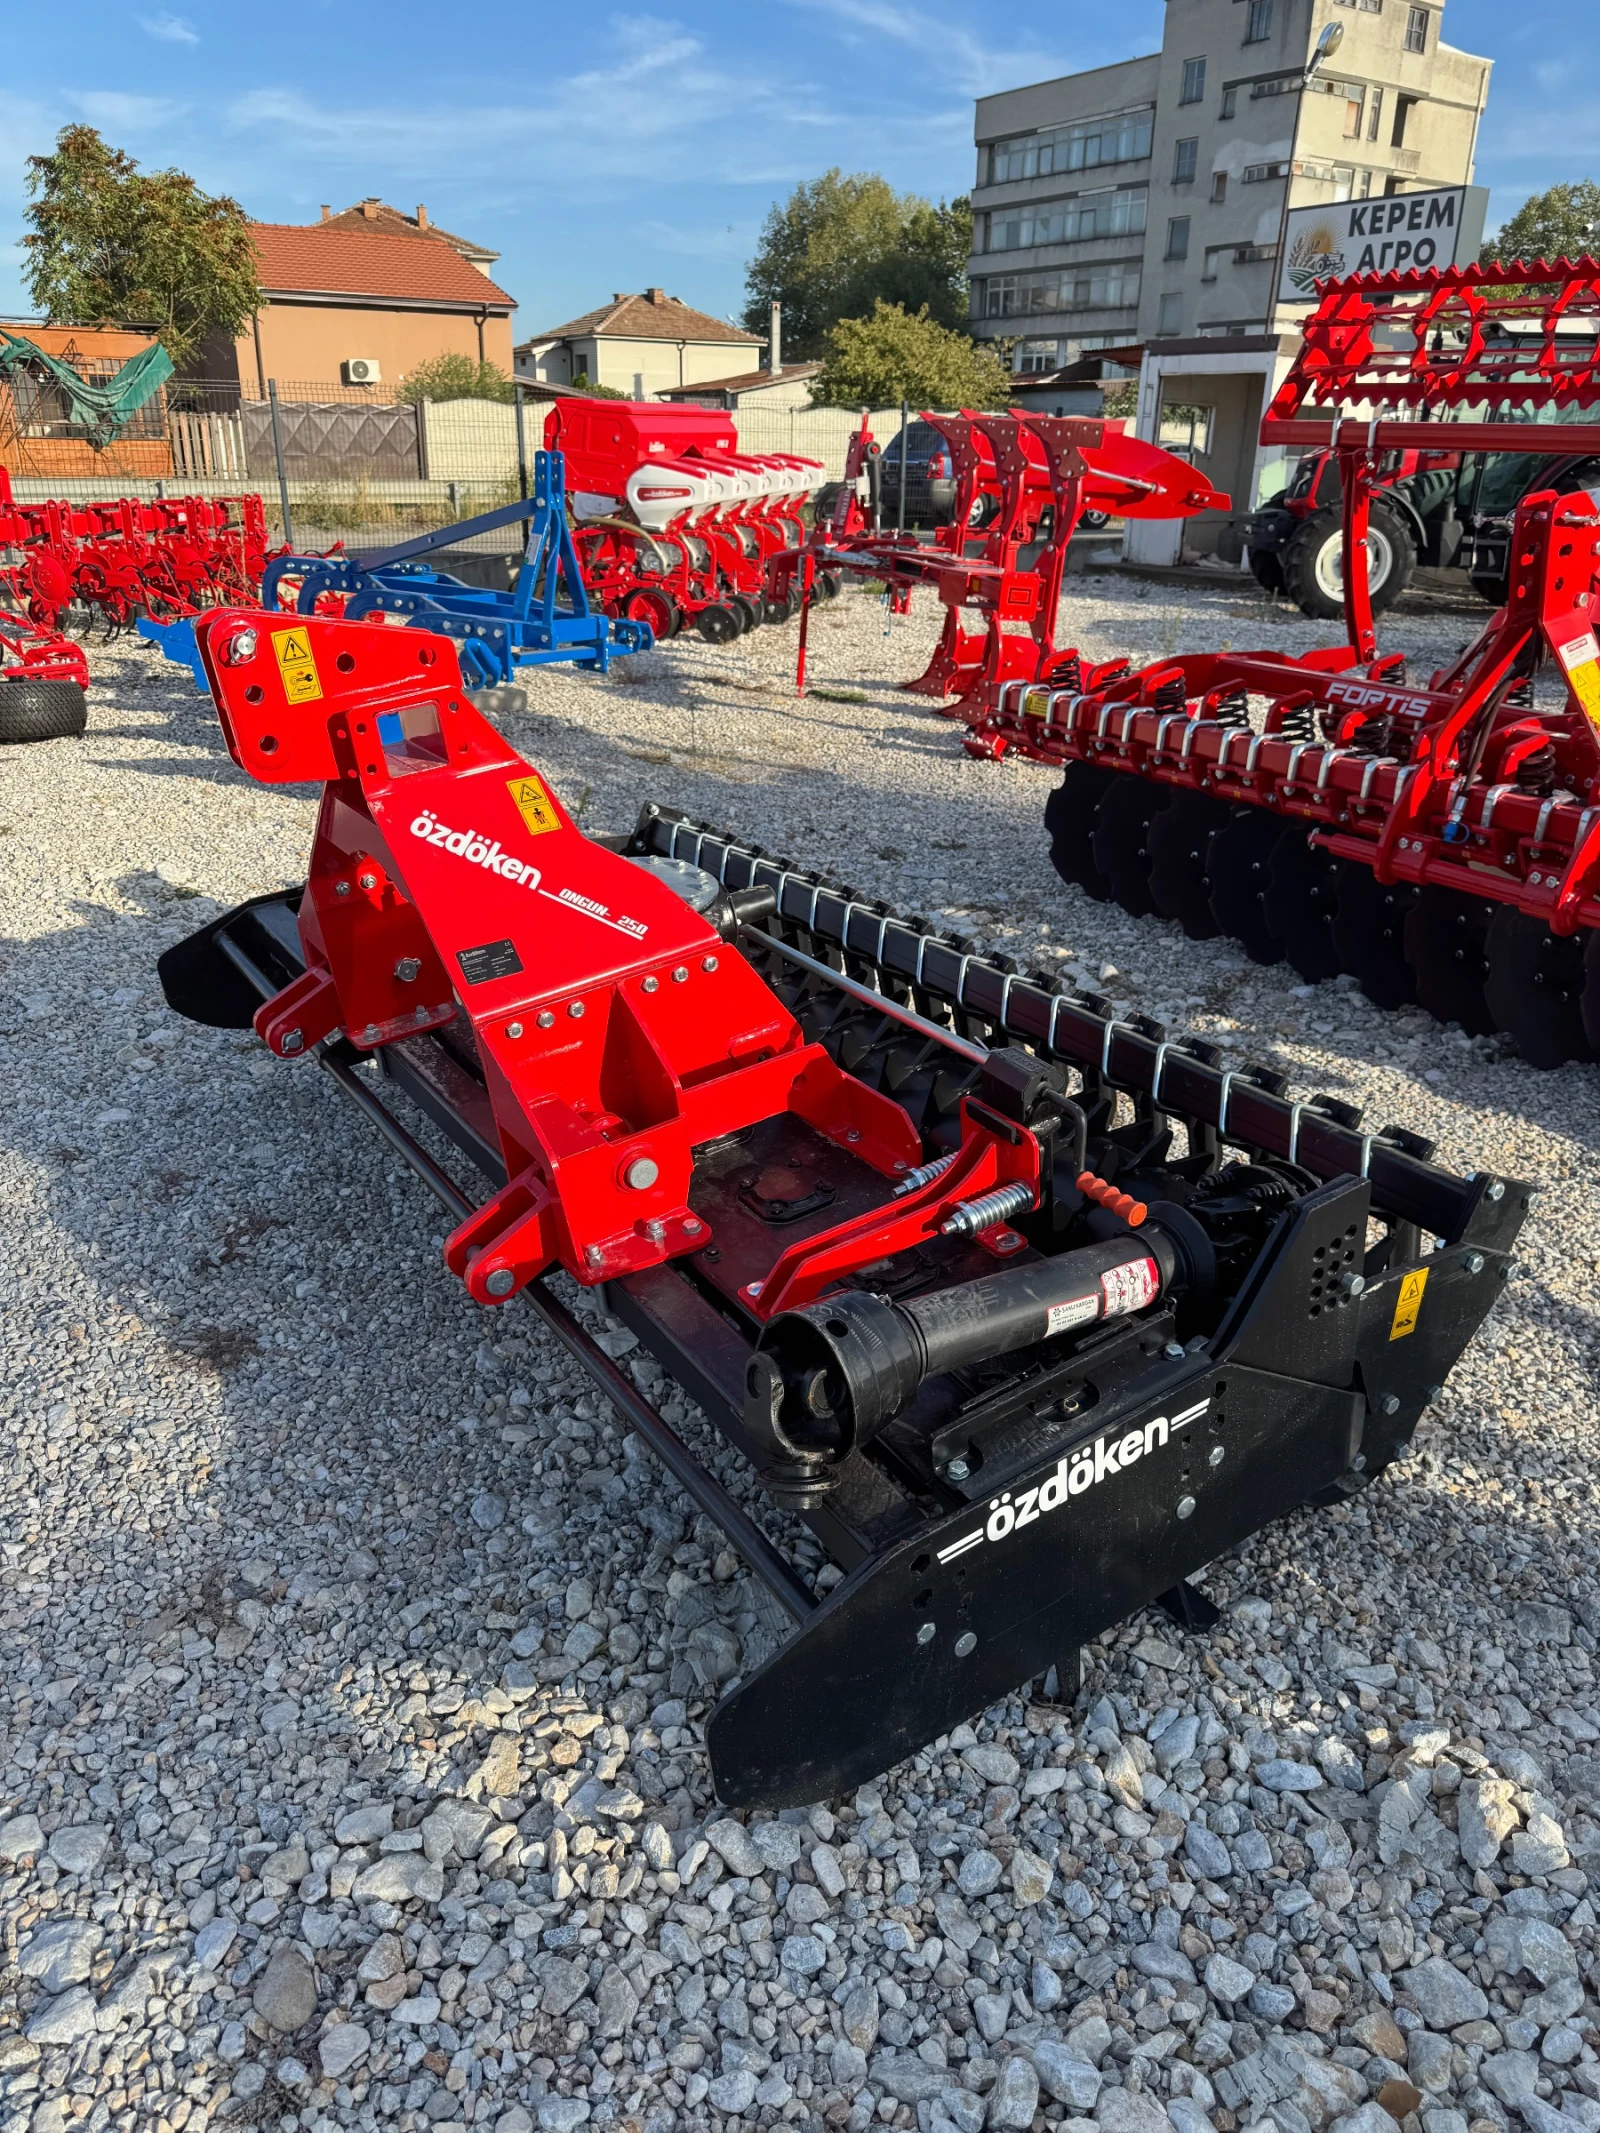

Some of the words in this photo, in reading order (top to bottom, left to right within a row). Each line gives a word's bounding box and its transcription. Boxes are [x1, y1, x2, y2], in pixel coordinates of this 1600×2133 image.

[1348, 196, 1455, 237] КЕРЕМ
[1356, 237, 1437, 272] АГРО
[409, 809, 542, 891] özdöken
[616, 914, 649, 935] 250
[986, 1415, 1169, 1542] özdöken
